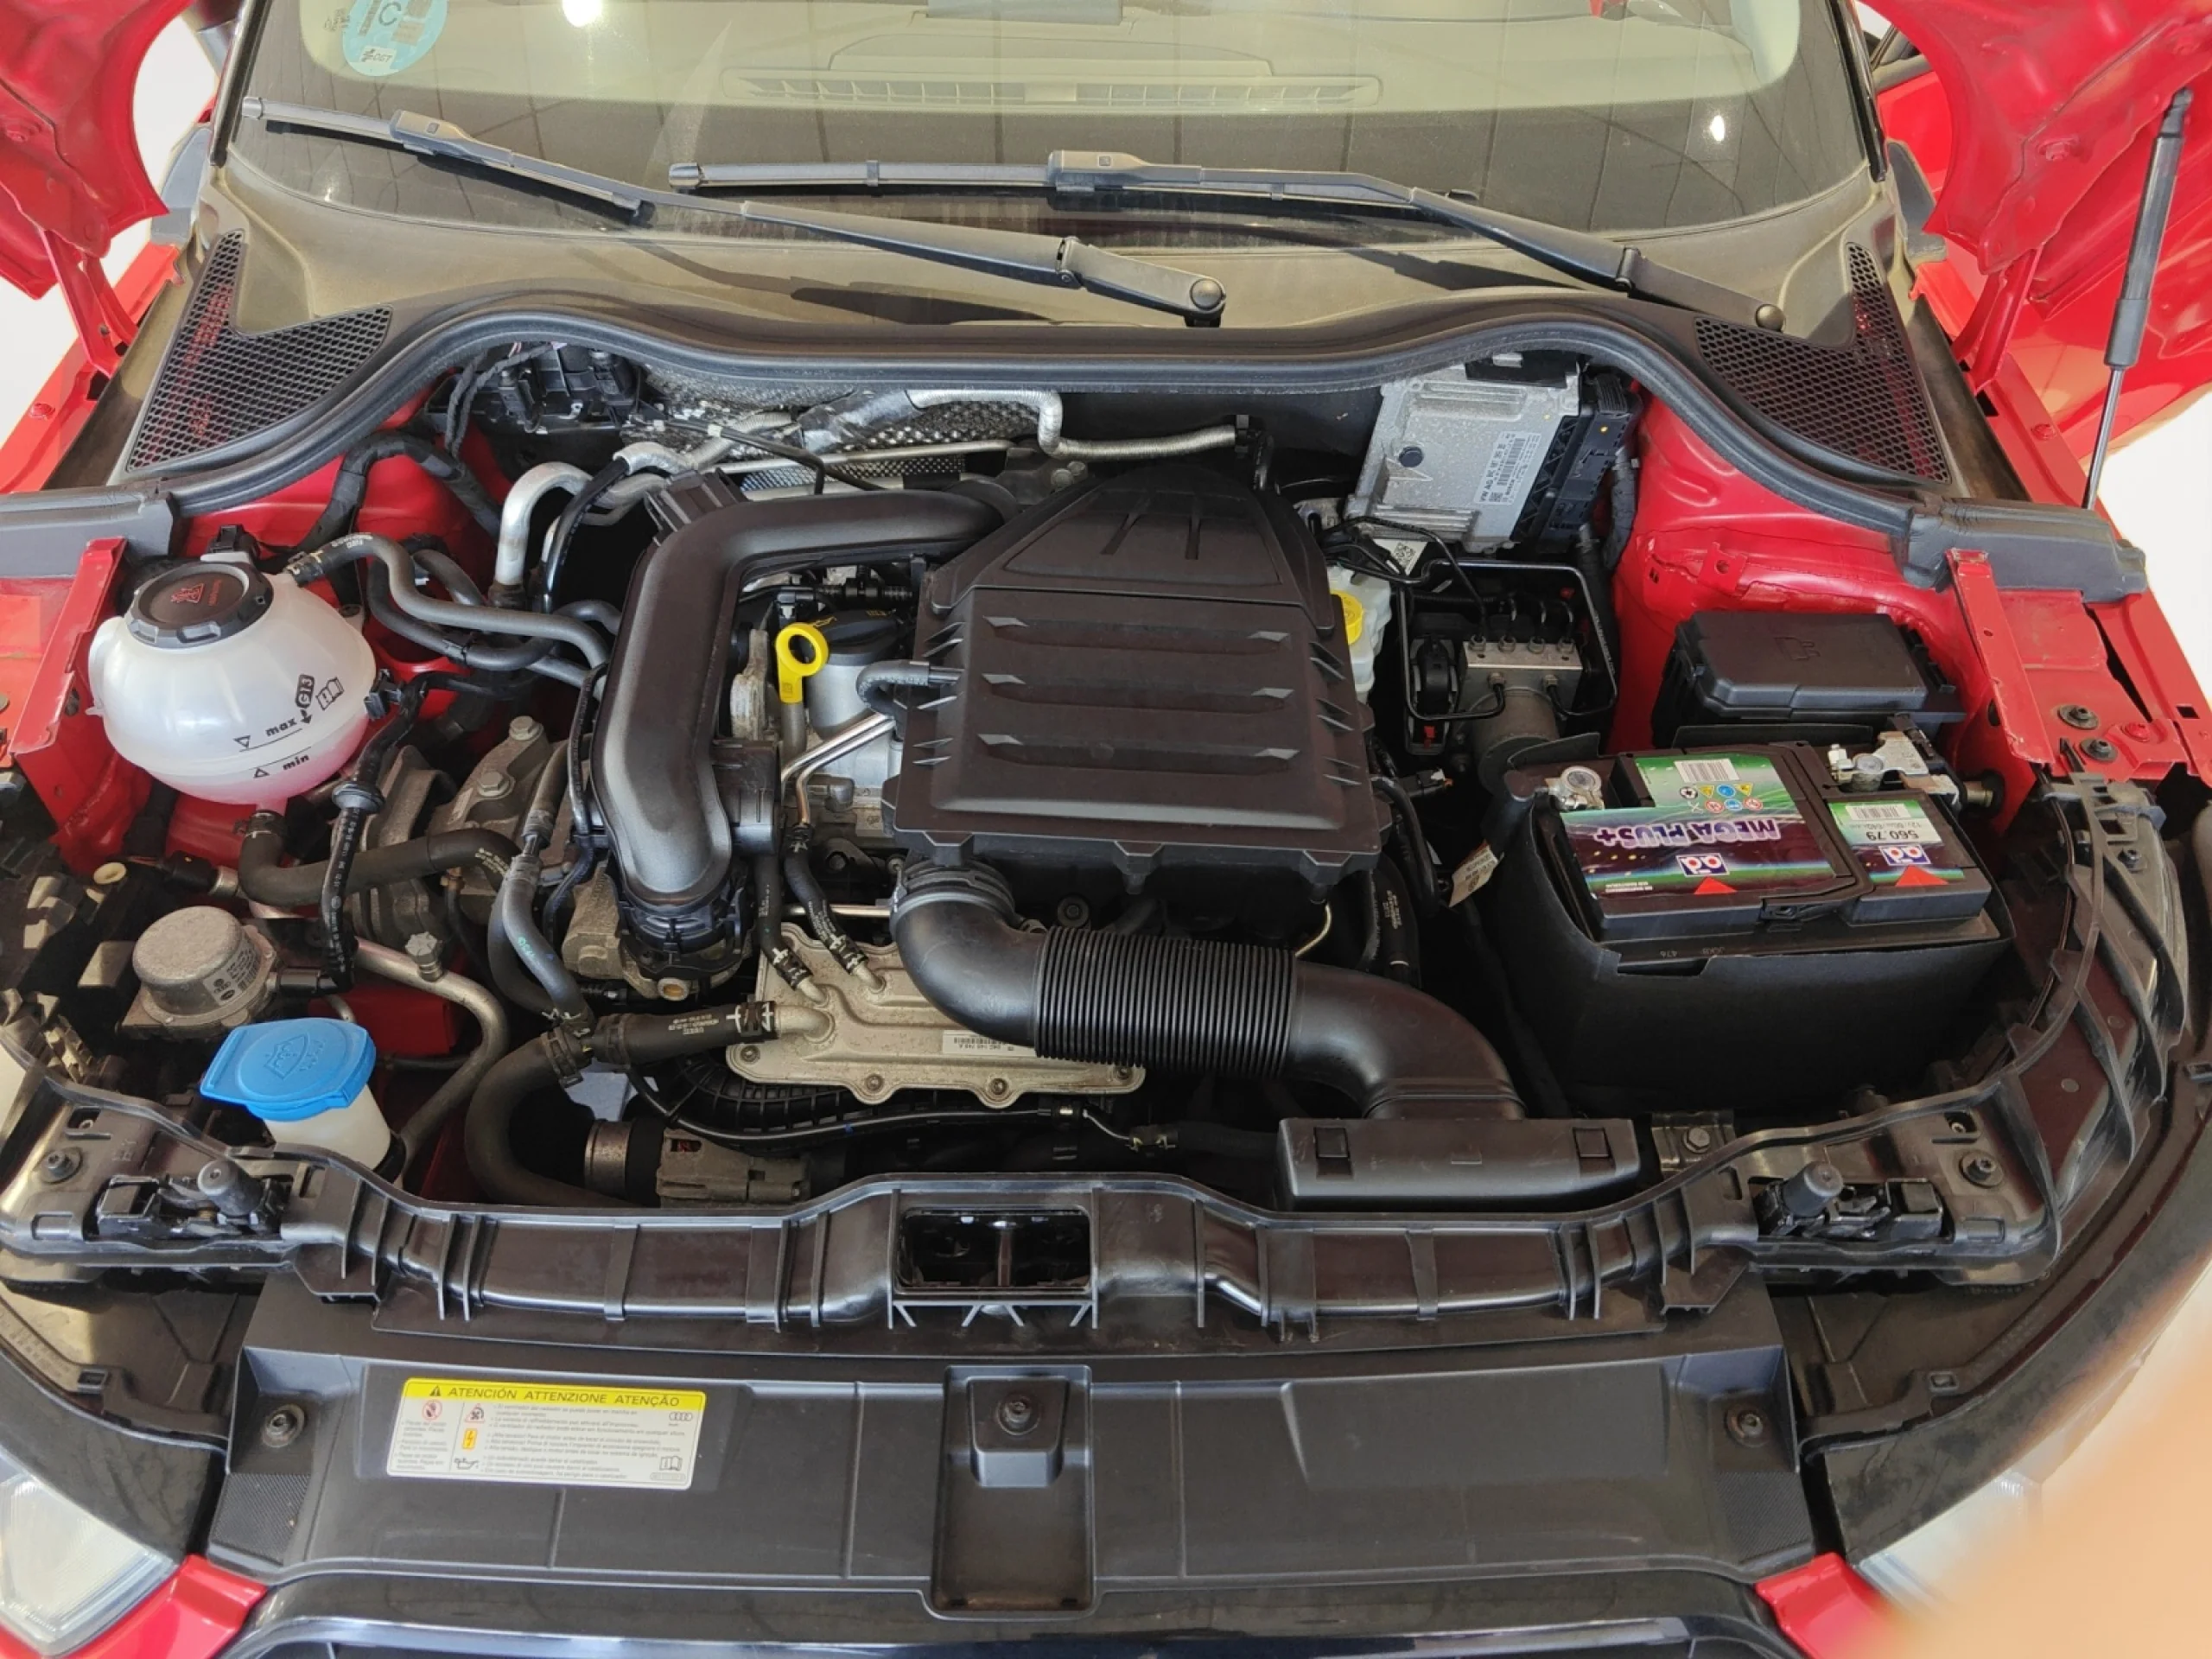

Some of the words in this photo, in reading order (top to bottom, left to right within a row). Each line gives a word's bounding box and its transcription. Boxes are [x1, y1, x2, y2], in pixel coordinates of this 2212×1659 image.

[378, 2, 402, 26] C
[266, 718, 297, 736] max
[283, 754, 309, 770] min
[1593, 821, 1690, 849] PLUS+
[1688, 818, 1782, 844] MEGA
[1866, 830, 1920, 842] 560.79
[448, 1386, 518, 1401] ATENCIÓN
[524, 1389, 607, 1404] ATTENZIONE
[613, 1392, 680, 1408] ATENÇÃO
